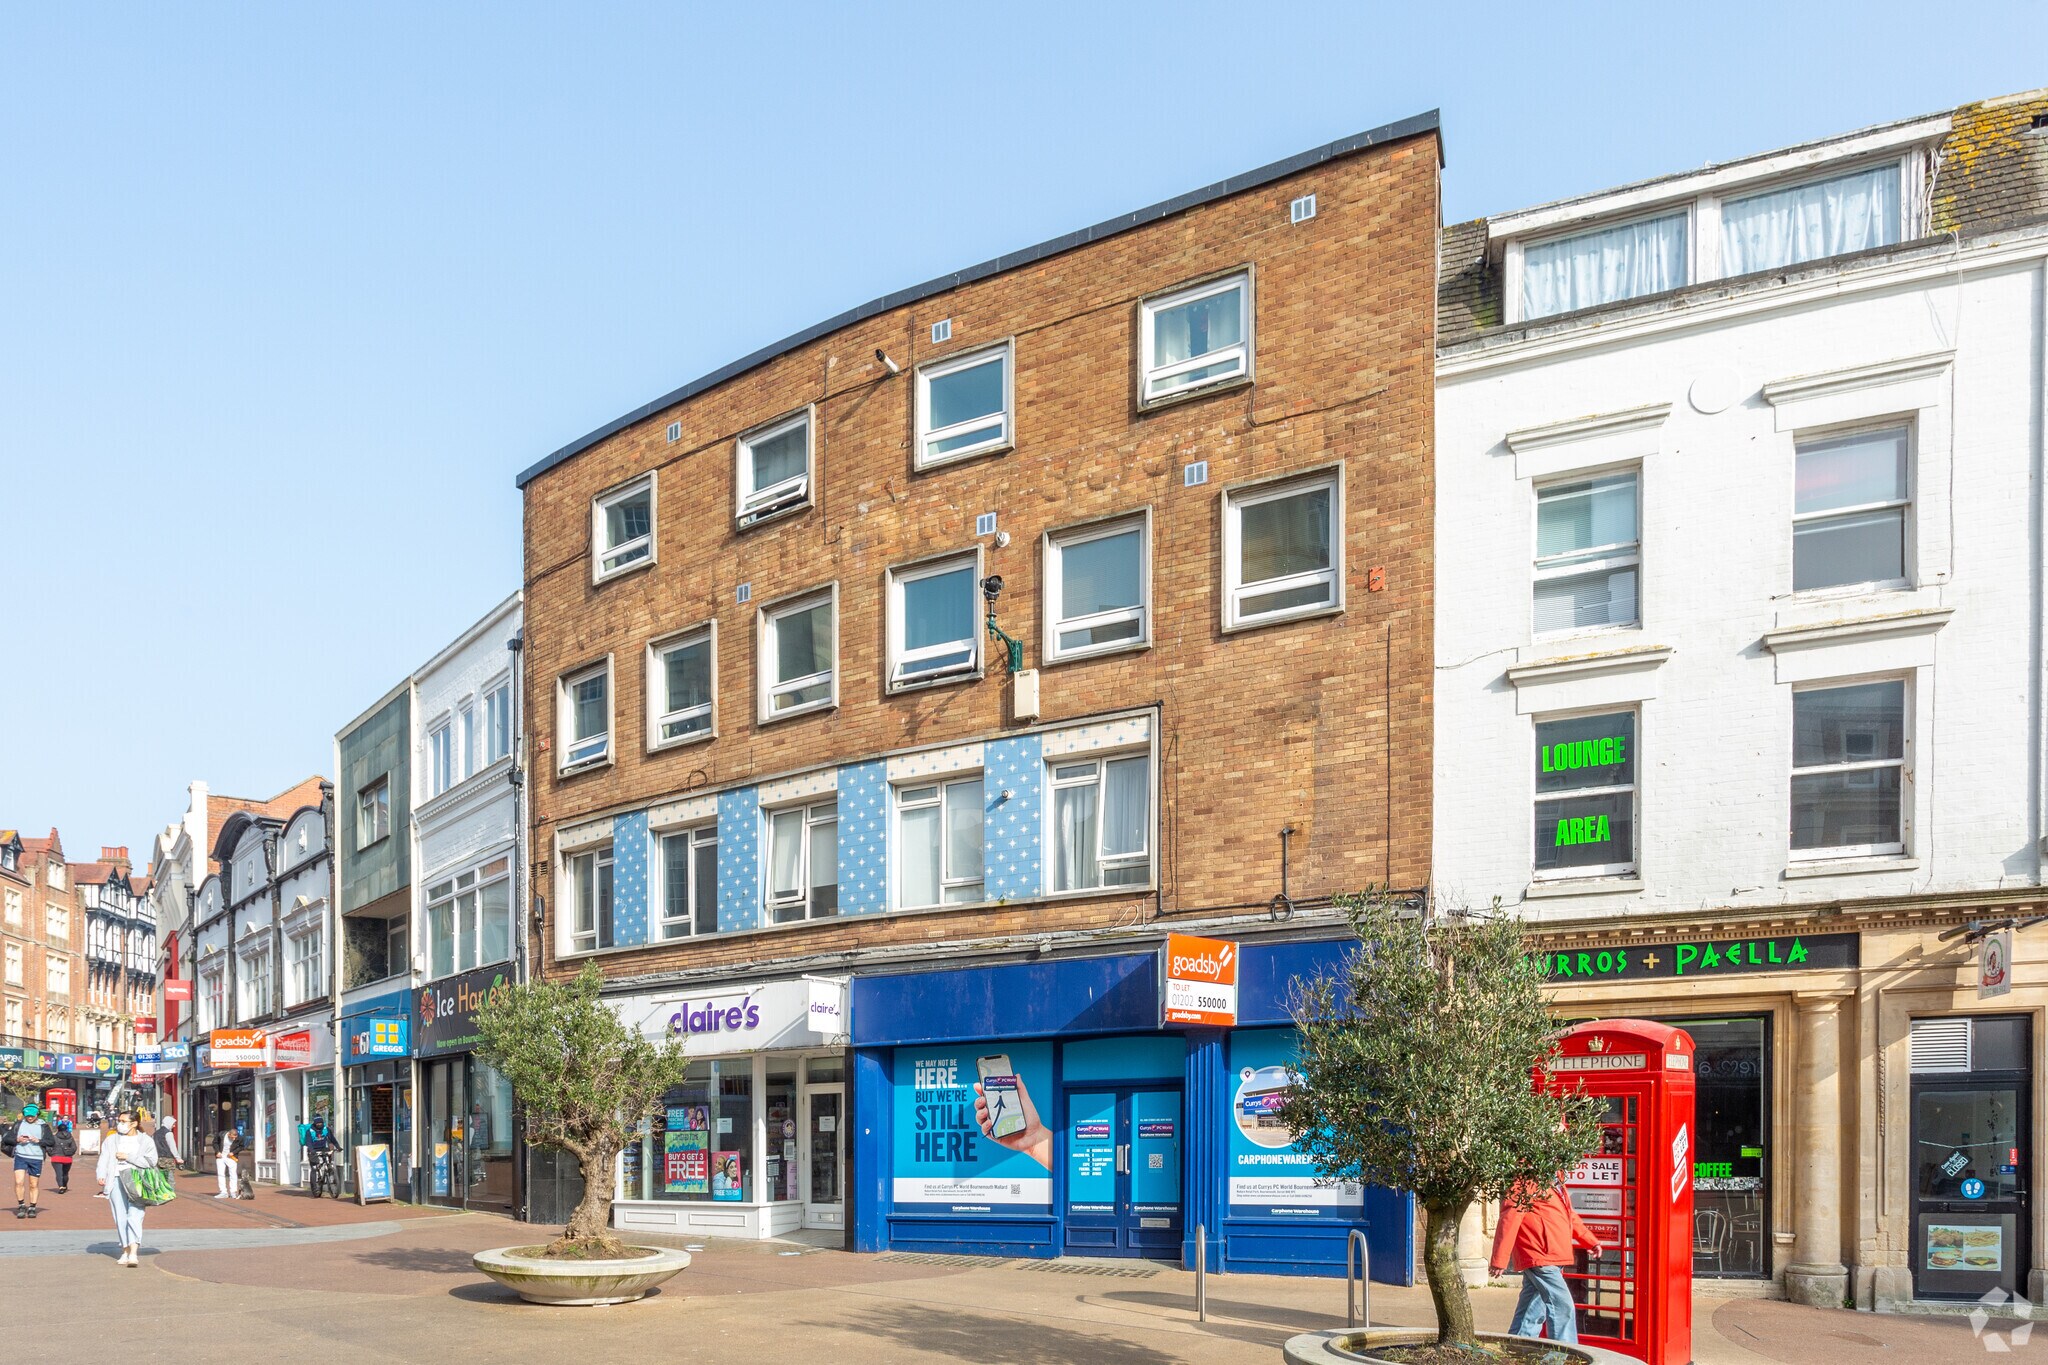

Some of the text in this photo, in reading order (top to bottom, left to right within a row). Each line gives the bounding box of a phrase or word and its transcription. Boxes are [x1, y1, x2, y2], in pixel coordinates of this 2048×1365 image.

[1543, 737, 1626, 773] LOUNGE
[1555, 815, 1611, 847] AREA
[1515, 950, 1628, 977] URROS
[1676, 936, 1809, 974] PAELLA
[1172, 952, 1222, 980] goadsby
[1173, 983, 1190, 992] TO LET
[436, 975, 511, 1018] Ice Harvet
[1172, 993, 1227, 1009] 01202 550000
[670, 997, 760, 1034] claire's
[810, 1003, 841, 1016] claire'
[1172, 1011, 1202, 1021] goadsby.com
[214, 1036, 256, 1049] goadsby
[373, 1044, 404, 1053] GREGGS
[62, 1056, 73, 1070] P
[915, 1058, 957, 1068] WE MAY NOT BE
[1554, 1054, 1642, 1069] TELEPHONE
[915, 1067, 968, 1090] HERE...
[915, 1089, 968, 1103] BUT WE'RE
[667, 1109, 685, 1118] FREE
[915, 1104, 970, 1131] STILL
[915, 1131, 978, 1163] HERE
[668, 1160, 705, 1179] FREE
[1591, 1162, 1619, 1170] SALE
[1693, 1162, 1732, 1178] COFFEE
[1568, 1171, 1619, 1181] TO LET
